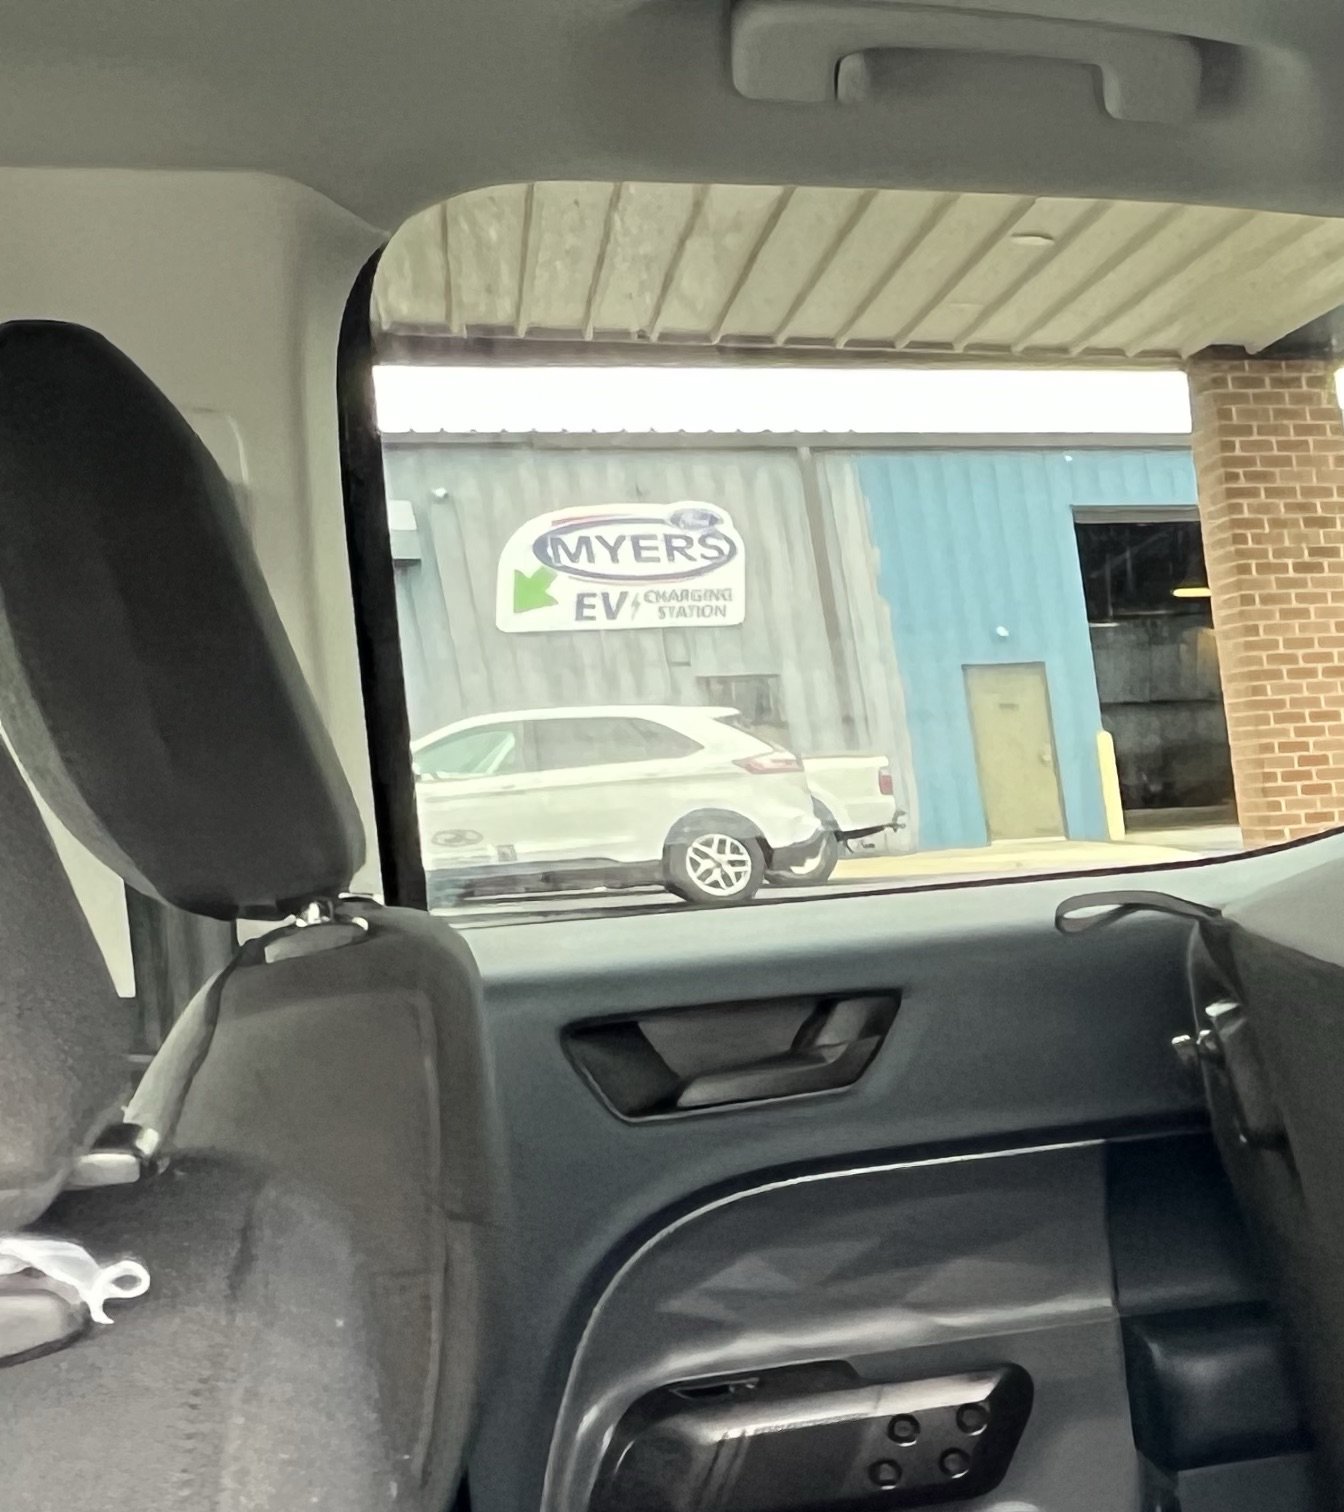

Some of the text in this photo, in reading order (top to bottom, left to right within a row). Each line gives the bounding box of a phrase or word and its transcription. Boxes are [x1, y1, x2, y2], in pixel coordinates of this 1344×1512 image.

[551, 532, 725, 565] MYERS
[574, 588, 733, 622] EV CHARGING
[658, 604, 727, 619] STATION
